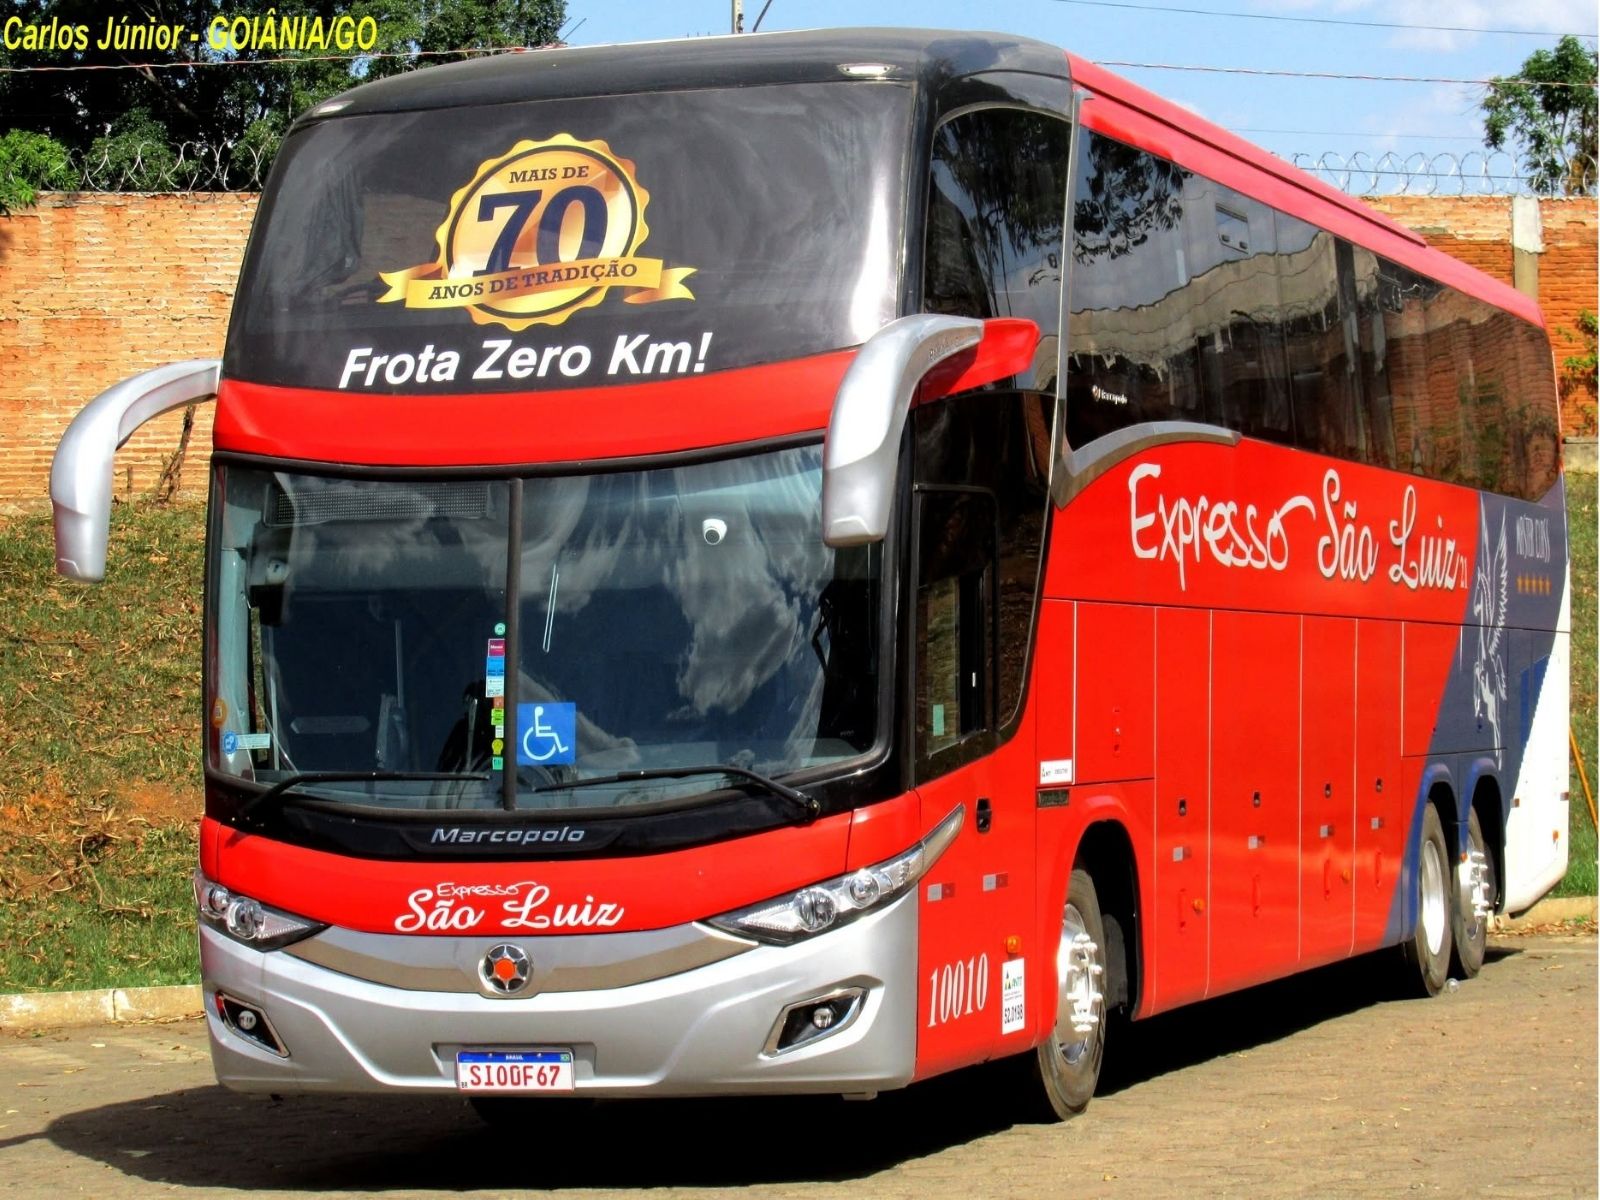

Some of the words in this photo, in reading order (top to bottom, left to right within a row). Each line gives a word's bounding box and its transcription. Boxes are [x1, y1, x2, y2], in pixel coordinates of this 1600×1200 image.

[509, 168, 557, 184] MAIS
[562, 165, 590, 179] DE
[472, 184, 608, 277] 70
[428, 282, 484, 300] ANOS
[488, 276, 518, 294] DE
[521, 259, 638, 288] TRADIÇÃO
[338, 344, 461, 389] Frota
[472, 338, 592, 382] Zero
[607, 331, 714, 376] Km!
[1127, 462, 1317, 592] Expresso
[1317, 468, 1379, 583] São
[1388, 484, 1459, 592] Luiz
[430, 825, 586, 846] Marcopolo
[393, 888, 486, 933] São
[500, 884, 625, 930] Luiz
[435, 880, 539, 900] Expresso
[927, 951, 989, 1028] 10010
